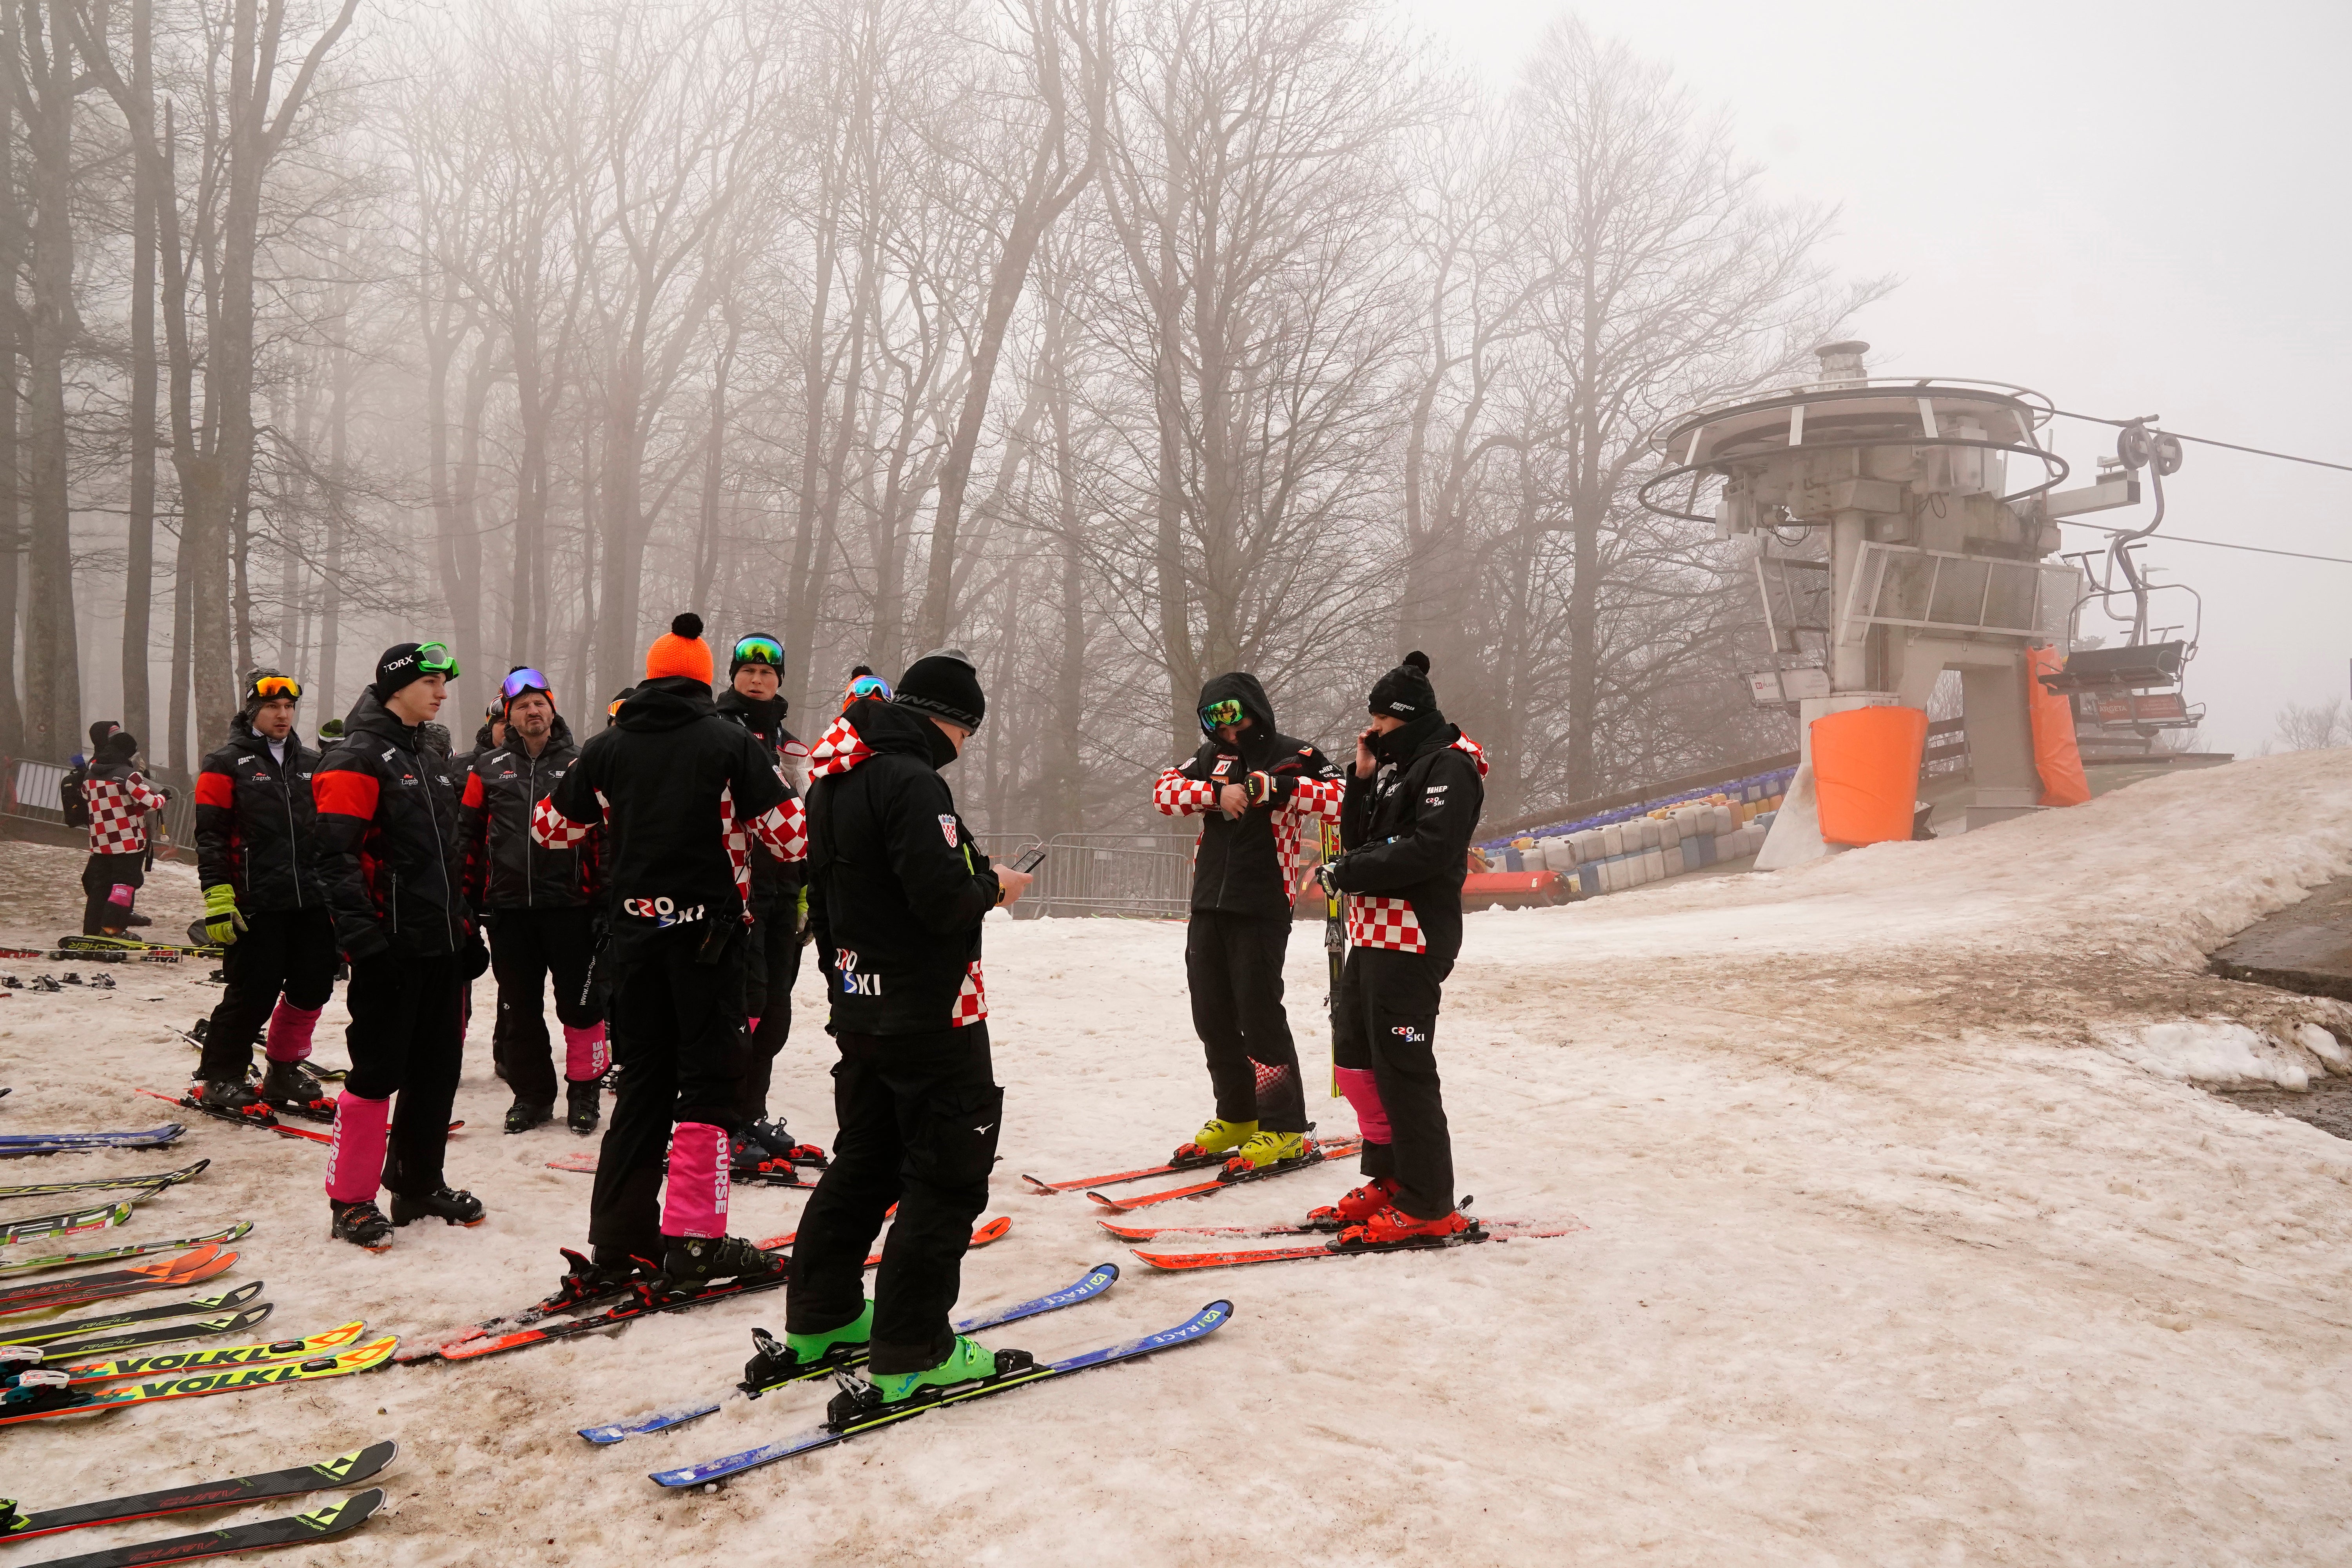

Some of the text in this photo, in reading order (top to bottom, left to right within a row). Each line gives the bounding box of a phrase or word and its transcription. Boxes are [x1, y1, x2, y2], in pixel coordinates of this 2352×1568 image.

[892, 694, 981, 725] YNAFIT
[1393, 701, 1415, 711] ENERGIA
[1216, 763, 1229, 772] A1
[1321, 875, 1332, 894] LEKI
[657, 904, 704, 928] SKI
[845, 972, 881, 995] SKI
[1391, 1027, 1414, 1035] CRO
[1406, 1034, 1425, 1042] SKI
[327, 1103, 342, 1185] COURSE
[715, 1131, 728, 1214] OURSE
[68, 1225, 102, 1234] elan
[309, 1465, 341, 1482] FISCHER
[292, 1515, 326, 1531] FISCHER
